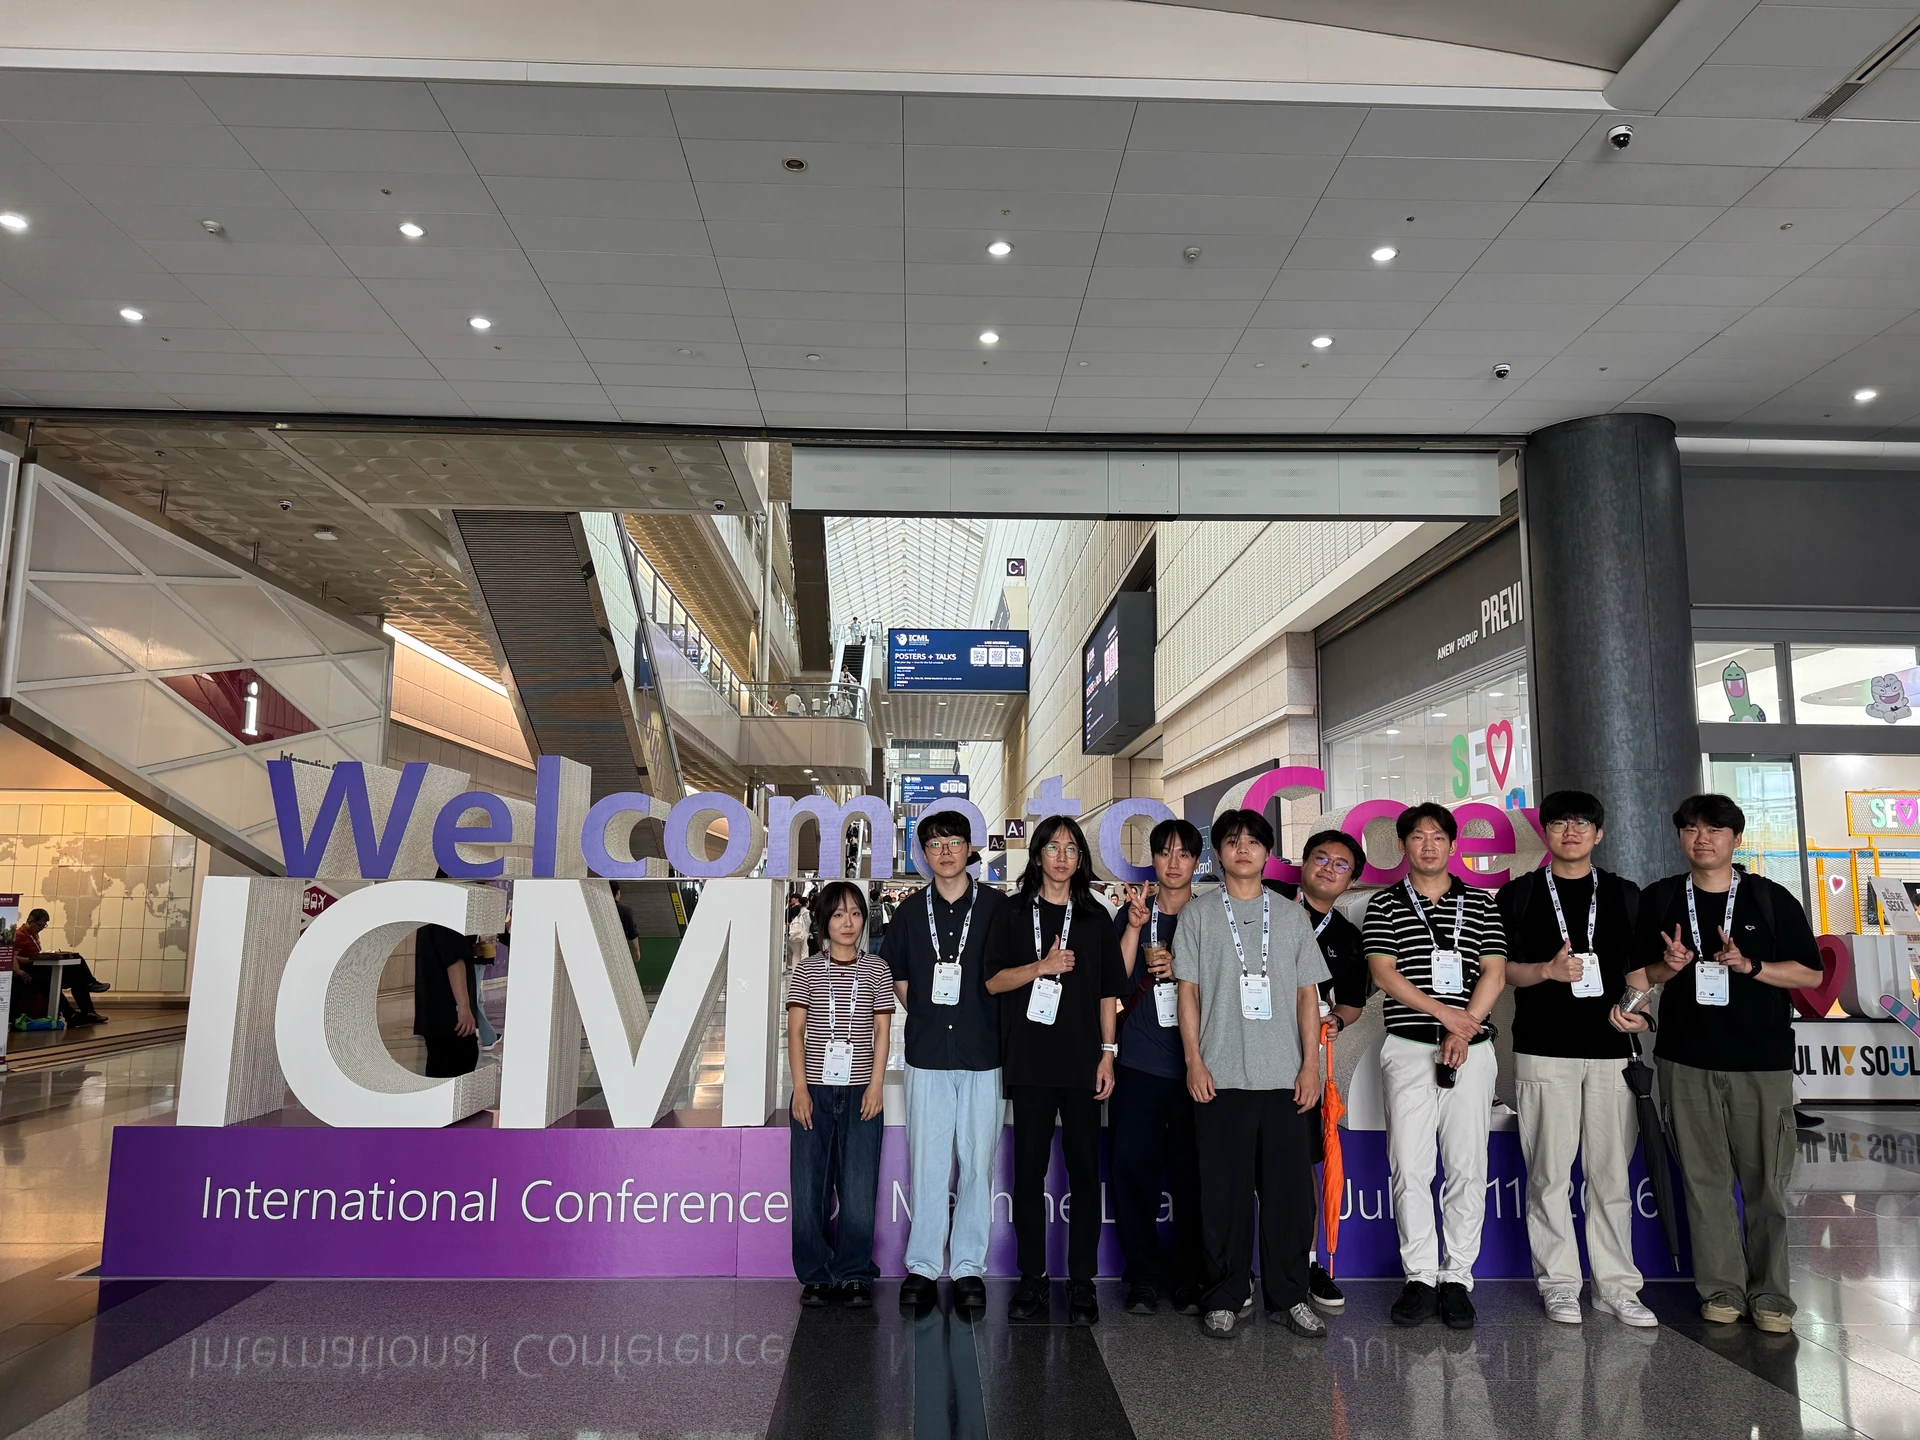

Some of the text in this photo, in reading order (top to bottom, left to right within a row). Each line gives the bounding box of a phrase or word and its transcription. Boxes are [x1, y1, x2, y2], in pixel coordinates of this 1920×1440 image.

[1008, 560, 1024, 575] C1
[908, 634, 930, 642] ICML
[1437, 640, 1456, 661] ANEW
[1457, 629, 1479, 651] POPUP
[935, 653, 957, 661] TALKS
[1007, 820, 1024, 837] A1
[989, 836, 1006, 851] A2
[176, 876, 908, 1129] ICM
[201, 1176, 498, 1222] International
[521, 1178, 790, 1224] Conference
[1339, 1177, 1395, 1220] Jul
